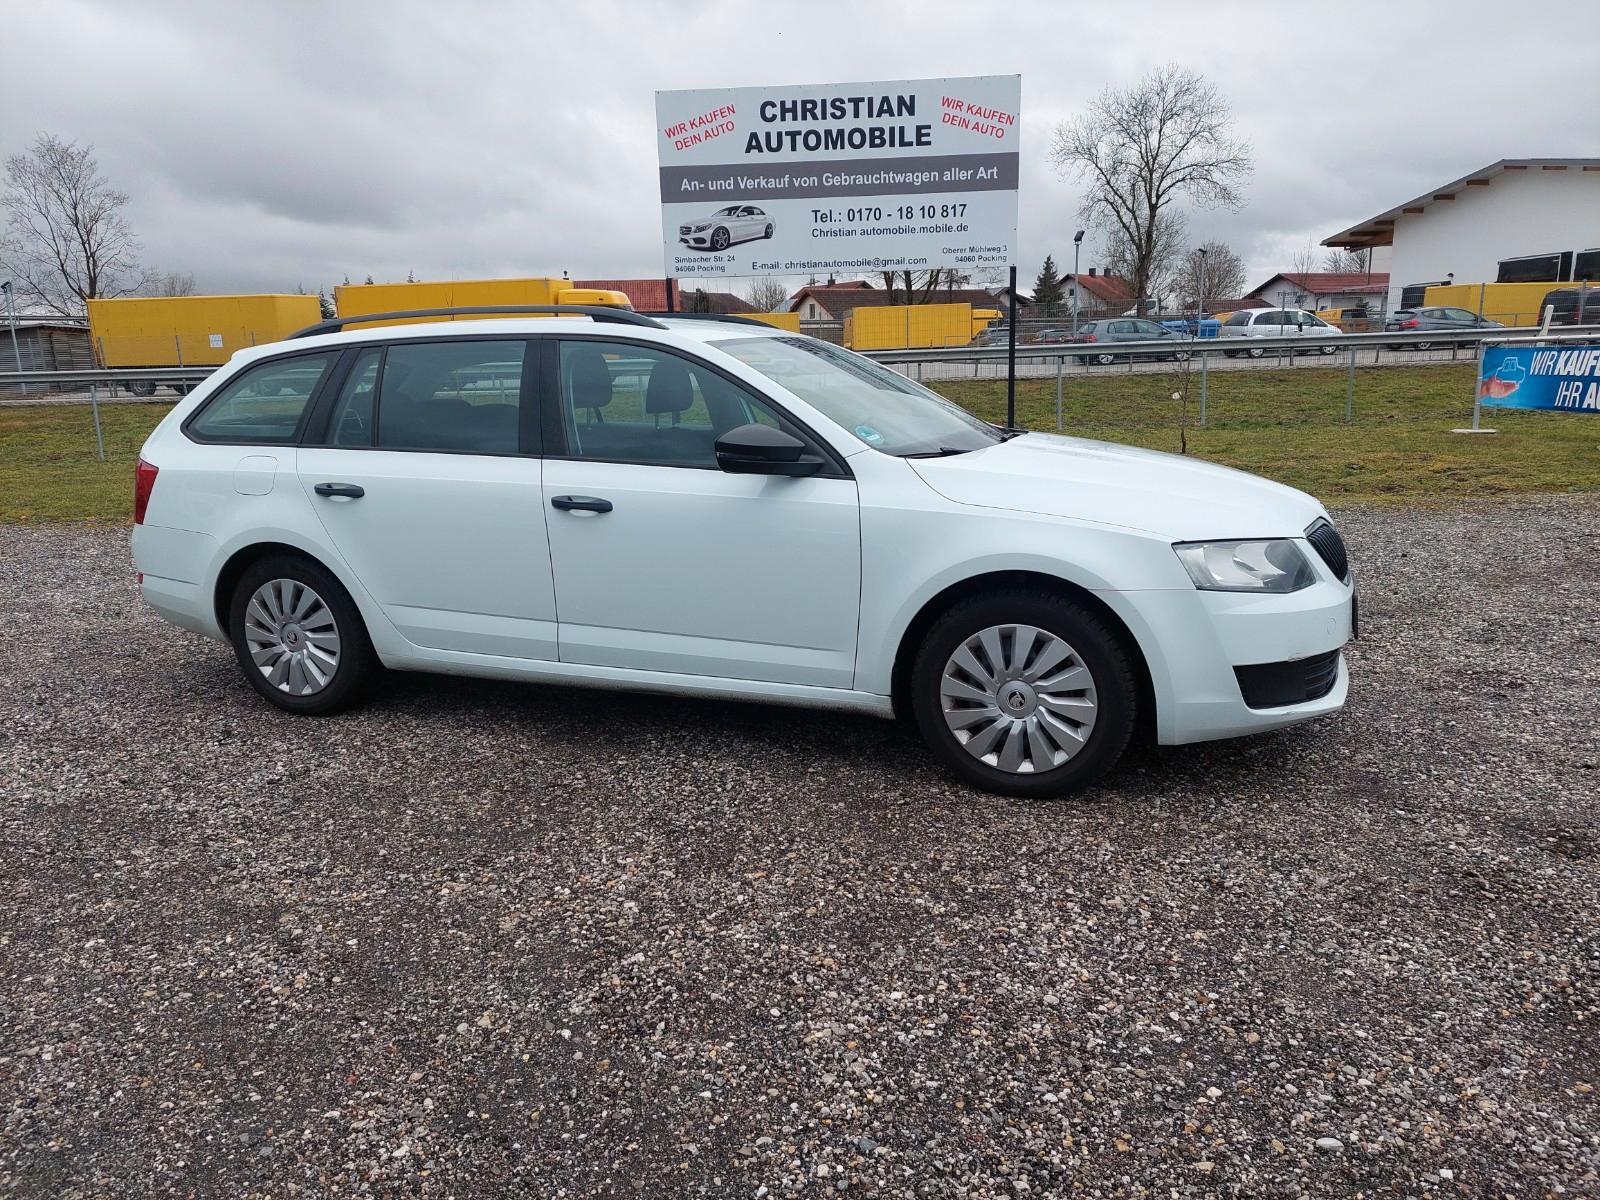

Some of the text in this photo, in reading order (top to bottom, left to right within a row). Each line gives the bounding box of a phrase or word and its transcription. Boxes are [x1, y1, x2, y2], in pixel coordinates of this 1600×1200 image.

[759, 94, 916, 123] CHRISTIAN
[941, 96, 1015, 126] WIR KAUFEN
[664, 103, 736, 139] WIR KAUFEN
[942, 112, 1005, 139] DEIN AUTO
[674, 120, 735, 151] DEIN AUTO
[744, 124, 932, 154] AUTOMOBILE
[680, 166, 999, 191] An- und Verkauf von Gebrauchtwagen aller Art
[811, 209, 842, 224] Tel.:
[847, 207, 882, 222] 0170
[896, 206, 914, 220] 18
[919, 205, 936, 219] 10
[940, 203, 968, 218] 817
[811, 223, 969, 238] Christian automobile.mobile.de
[674, 254, 736, 264] Simbacher Str. 24
[955, 254, 1007, 263] 94060 Pocking
[1002, 244, 1008, 252] 3
[675, 264, 726, 273] 94060 Pocking
[752, 257, 927, 270] E-mail: christianautomobile@gmail.com
[1530, 351, 1558, 375] WIR
[1554, 381, 1583, 407] IHR
